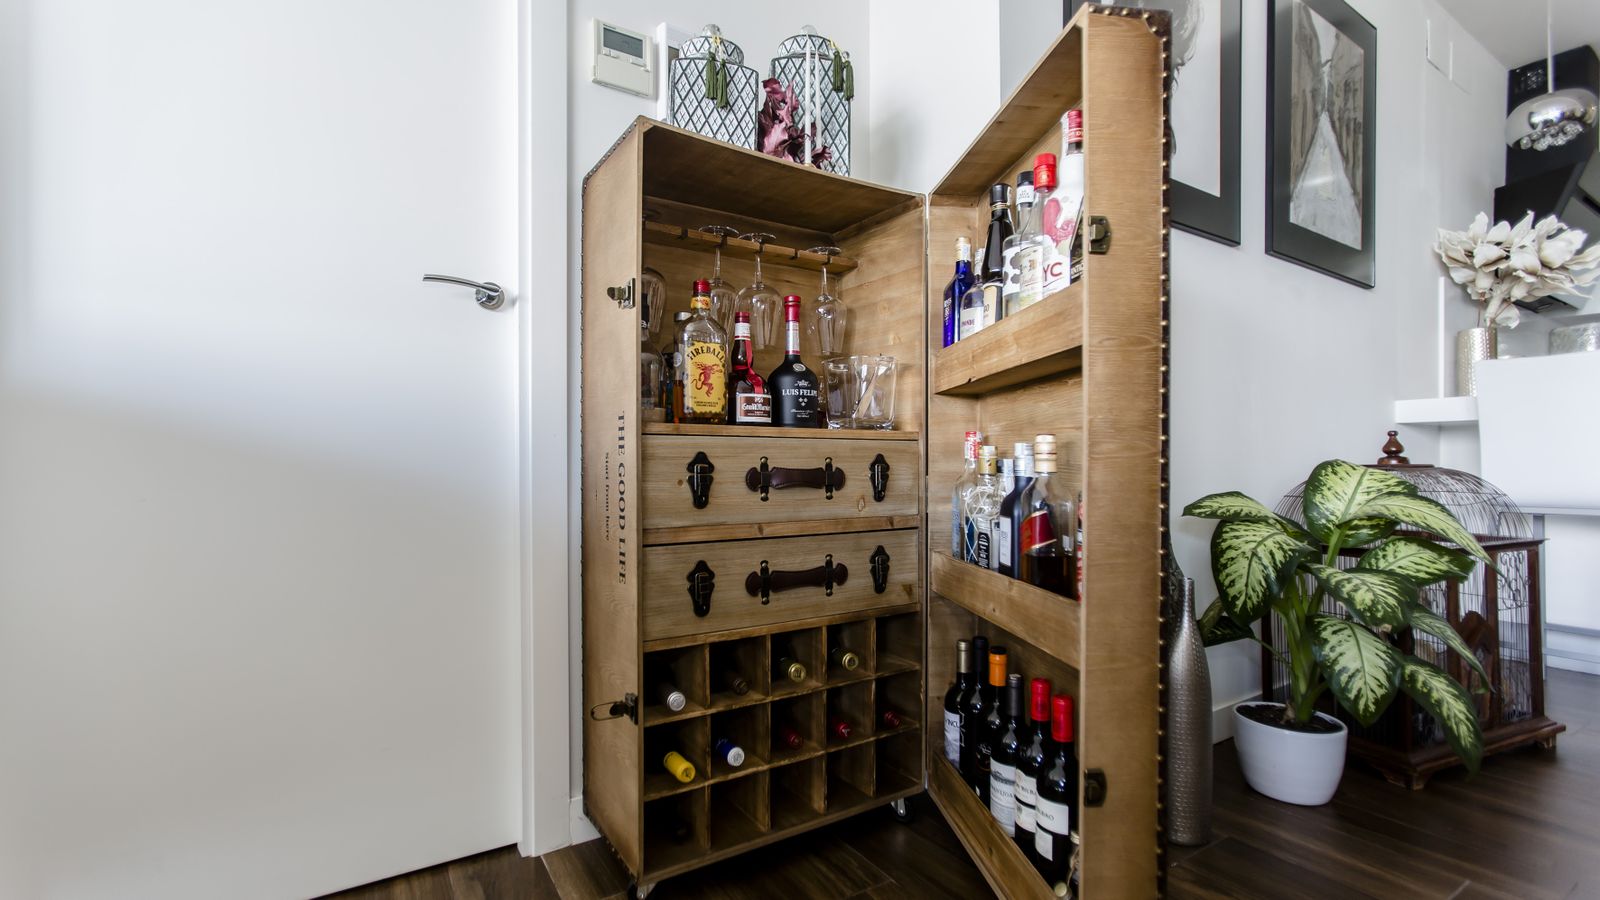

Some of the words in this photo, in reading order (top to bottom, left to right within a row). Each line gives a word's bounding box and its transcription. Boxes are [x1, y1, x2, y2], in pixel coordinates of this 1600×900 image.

[1043, 262, 1063, 281] YC
[687, 346, 726, 364] FIREBALL
[782, 388, 799, 396] LUIS
[617, 411, 626, 456] THE
[617, 463, 626, 530] GOOD
[618, 537, 627, 585] LIFE
